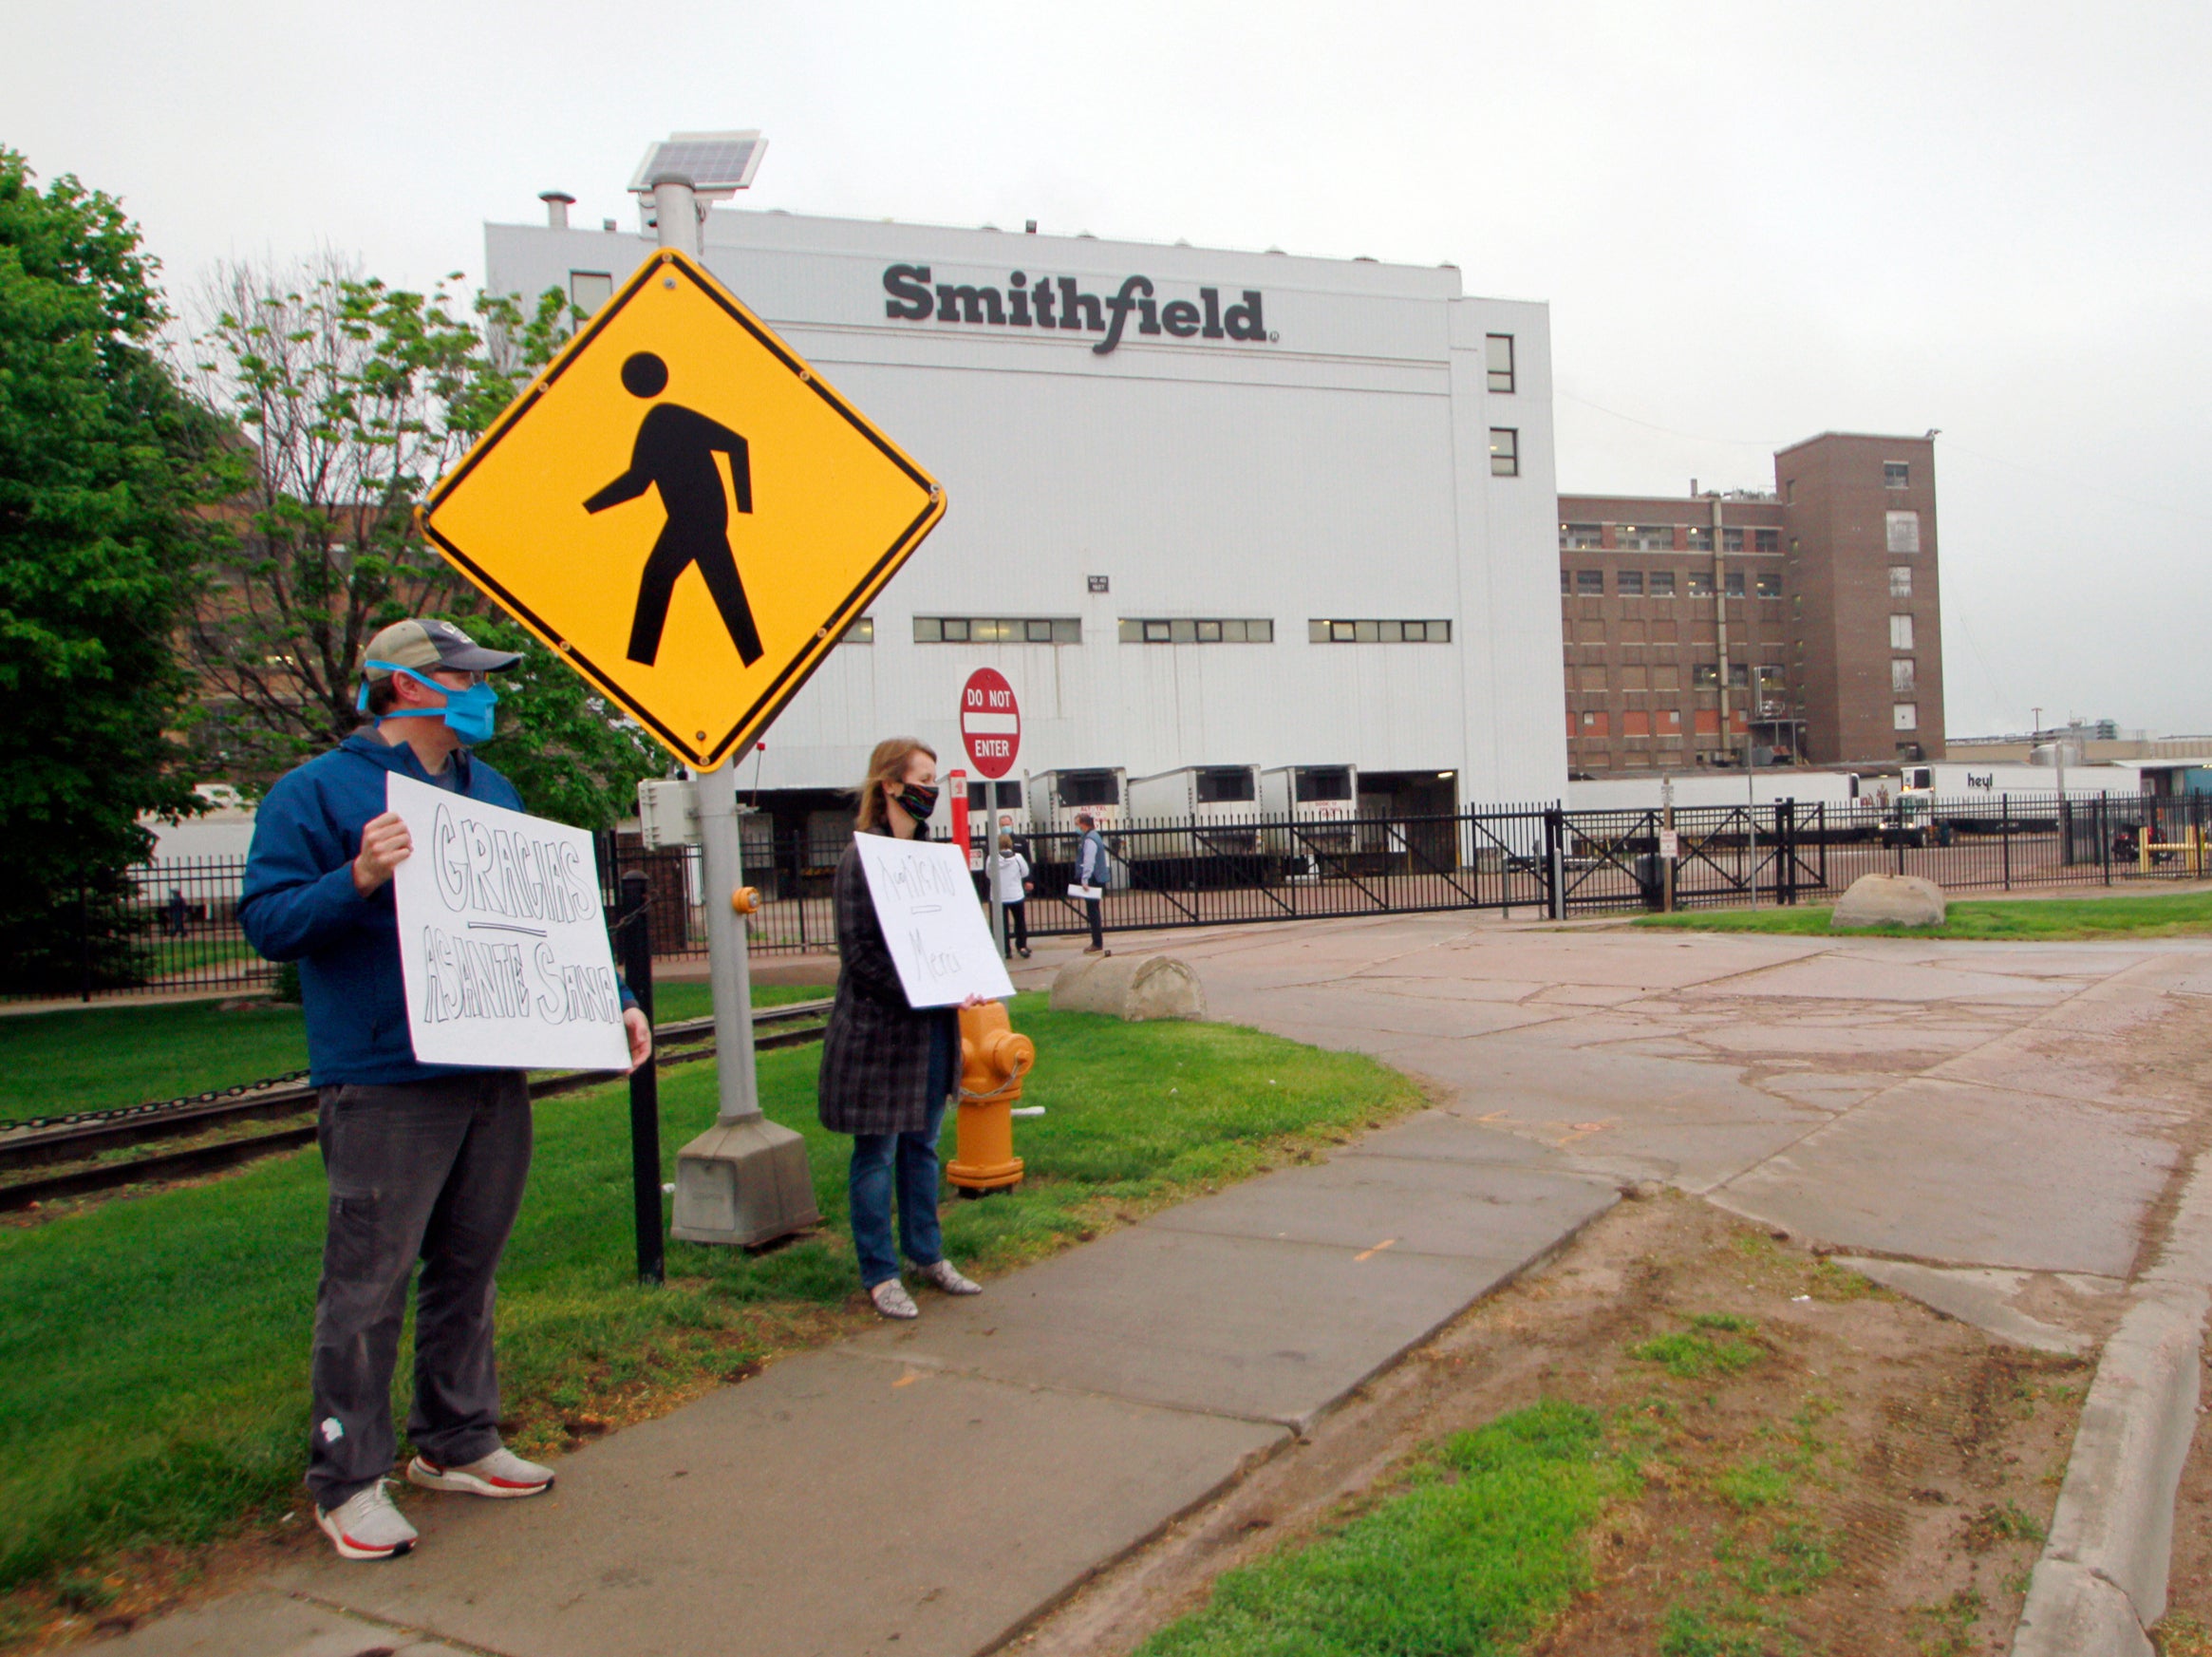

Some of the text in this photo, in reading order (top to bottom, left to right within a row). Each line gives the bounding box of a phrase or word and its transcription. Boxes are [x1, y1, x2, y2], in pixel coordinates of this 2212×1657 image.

[882, 263, 1267, 355] Smithfield
[967, 688, 1011, 707] DO NOT
[974, 740, 1010, 758] ENTER
[1967, 772, 1993, 791] heyl
[433, 802, 597, 923] GRACIAS
[423, 925, 623, 1026] ASANTE SANA
